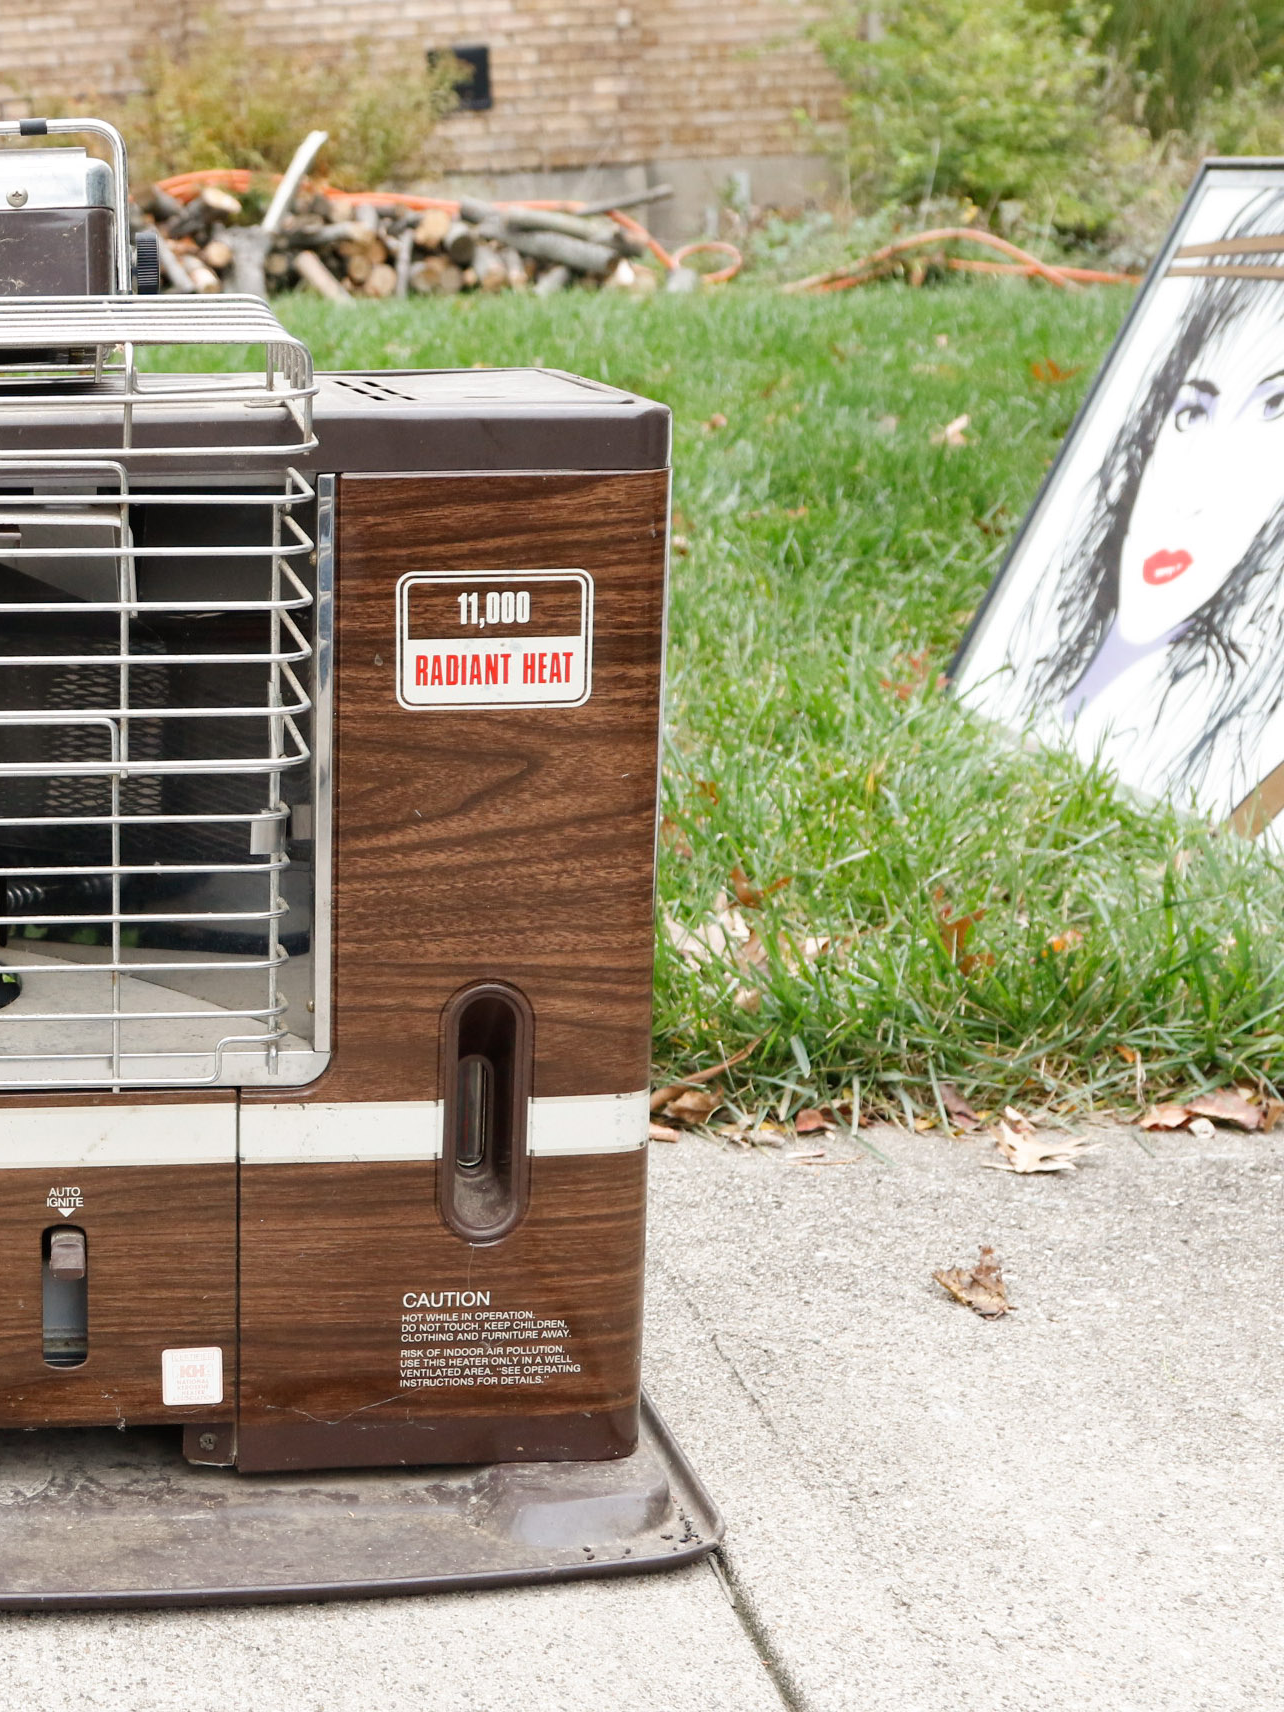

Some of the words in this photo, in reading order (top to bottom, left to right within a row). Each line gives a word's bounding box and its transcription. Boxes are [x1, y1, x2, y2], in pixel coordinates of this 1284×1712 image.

[457, 591, 531, 629] 11,000
[415, 653, 512, 686] RADIANT
[522, 652, 574, 684] HEAT
[48, 1187, 81, 1197] AUTO
[46, 1197, 84, 1207] IGNITE
[402, 1291, 491, 1308] CAUTION
[402, 1314, 423, 1323] HOT
[425, 1313, 459, 1322] WHILE
[461, 1312, 472, 1321] IN
[474, 1310, 536, 1321] OPERATION.
[401, 1324, 417, 1333] DO
[419, 1323, 442, 1332] NOT
[444, 1322, 481, 1332] TOUCH.
[484, 1321, 510, 1330] KEEP
[401, 1332, 453, 1343] CLOTHING
[456, 1332, 479, 1341] AND
[481, 1330, 538, 1340] FURNITURE
[541, 1329, 572, 1339] AWAY.
[401, 1349, 424, 1358] RISK
[427, 1349, 440, 1357] OF
[443, 1347, 484, 1357] INDOOR
[486, 1347, 504, 1356] AIR
[506, 1345, 565, 1355] POLLUTION.
[400, 1359, 420, 1368] USE
[423, 1358, 446, 1367] THIS
[449, 1357, 488, 1366] HEATER
[491, 1356, 518, 1365] ONLY
[522, 1356, 532, 1364] IN
[535, 1355, 542, 1364] A
[545, 1354, 572, 1364] WELL
[400, 1368, 461, 1378] VENTILATED
[523, 1364, 581, 1374] OPERATING
[400, 1377, 474, 1388] INSTRUCTIONS
[477, 1376, 498, 1385] FOR
